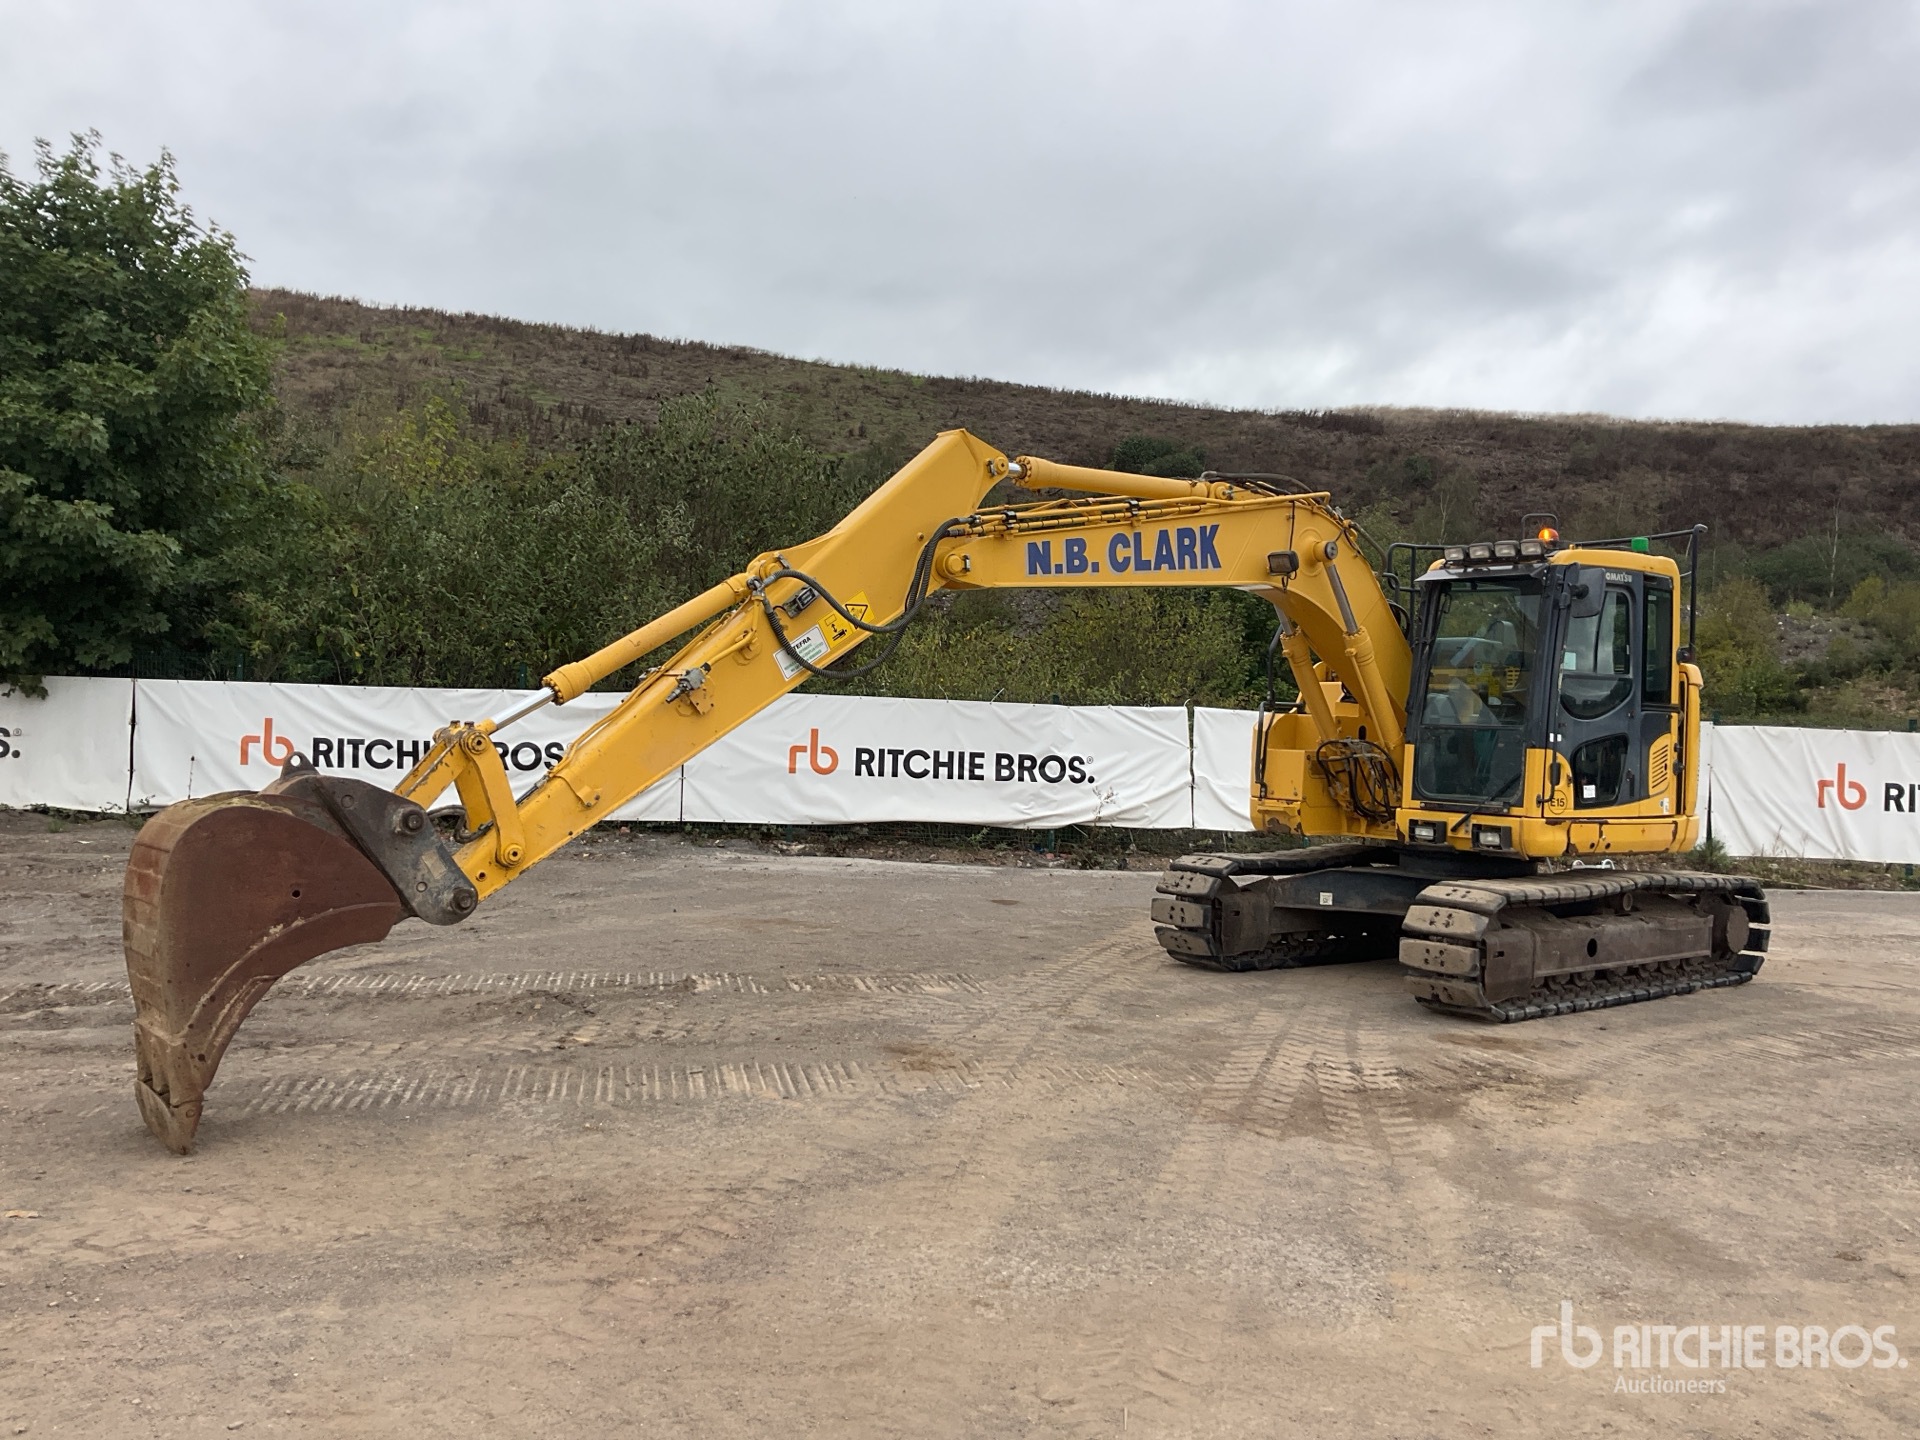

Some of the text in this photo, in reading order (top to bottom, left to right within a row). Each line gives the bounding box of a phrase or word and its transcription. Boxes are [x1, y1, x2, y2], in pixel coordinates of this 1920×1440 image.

[1027, 524, 1222, 575] N.B. CLARK
[1605, 572, 1632, 582] OMATSU
[312, 737, 431, 770] RITCH
[496, 741, 565, 771] ROS
[788, 728, 839, 775] rb
[854, 747, 985, 781] RITCHIE
[1550, 797, 1565, 807] E15
[1817, 763, 1920, 813] rb RI
